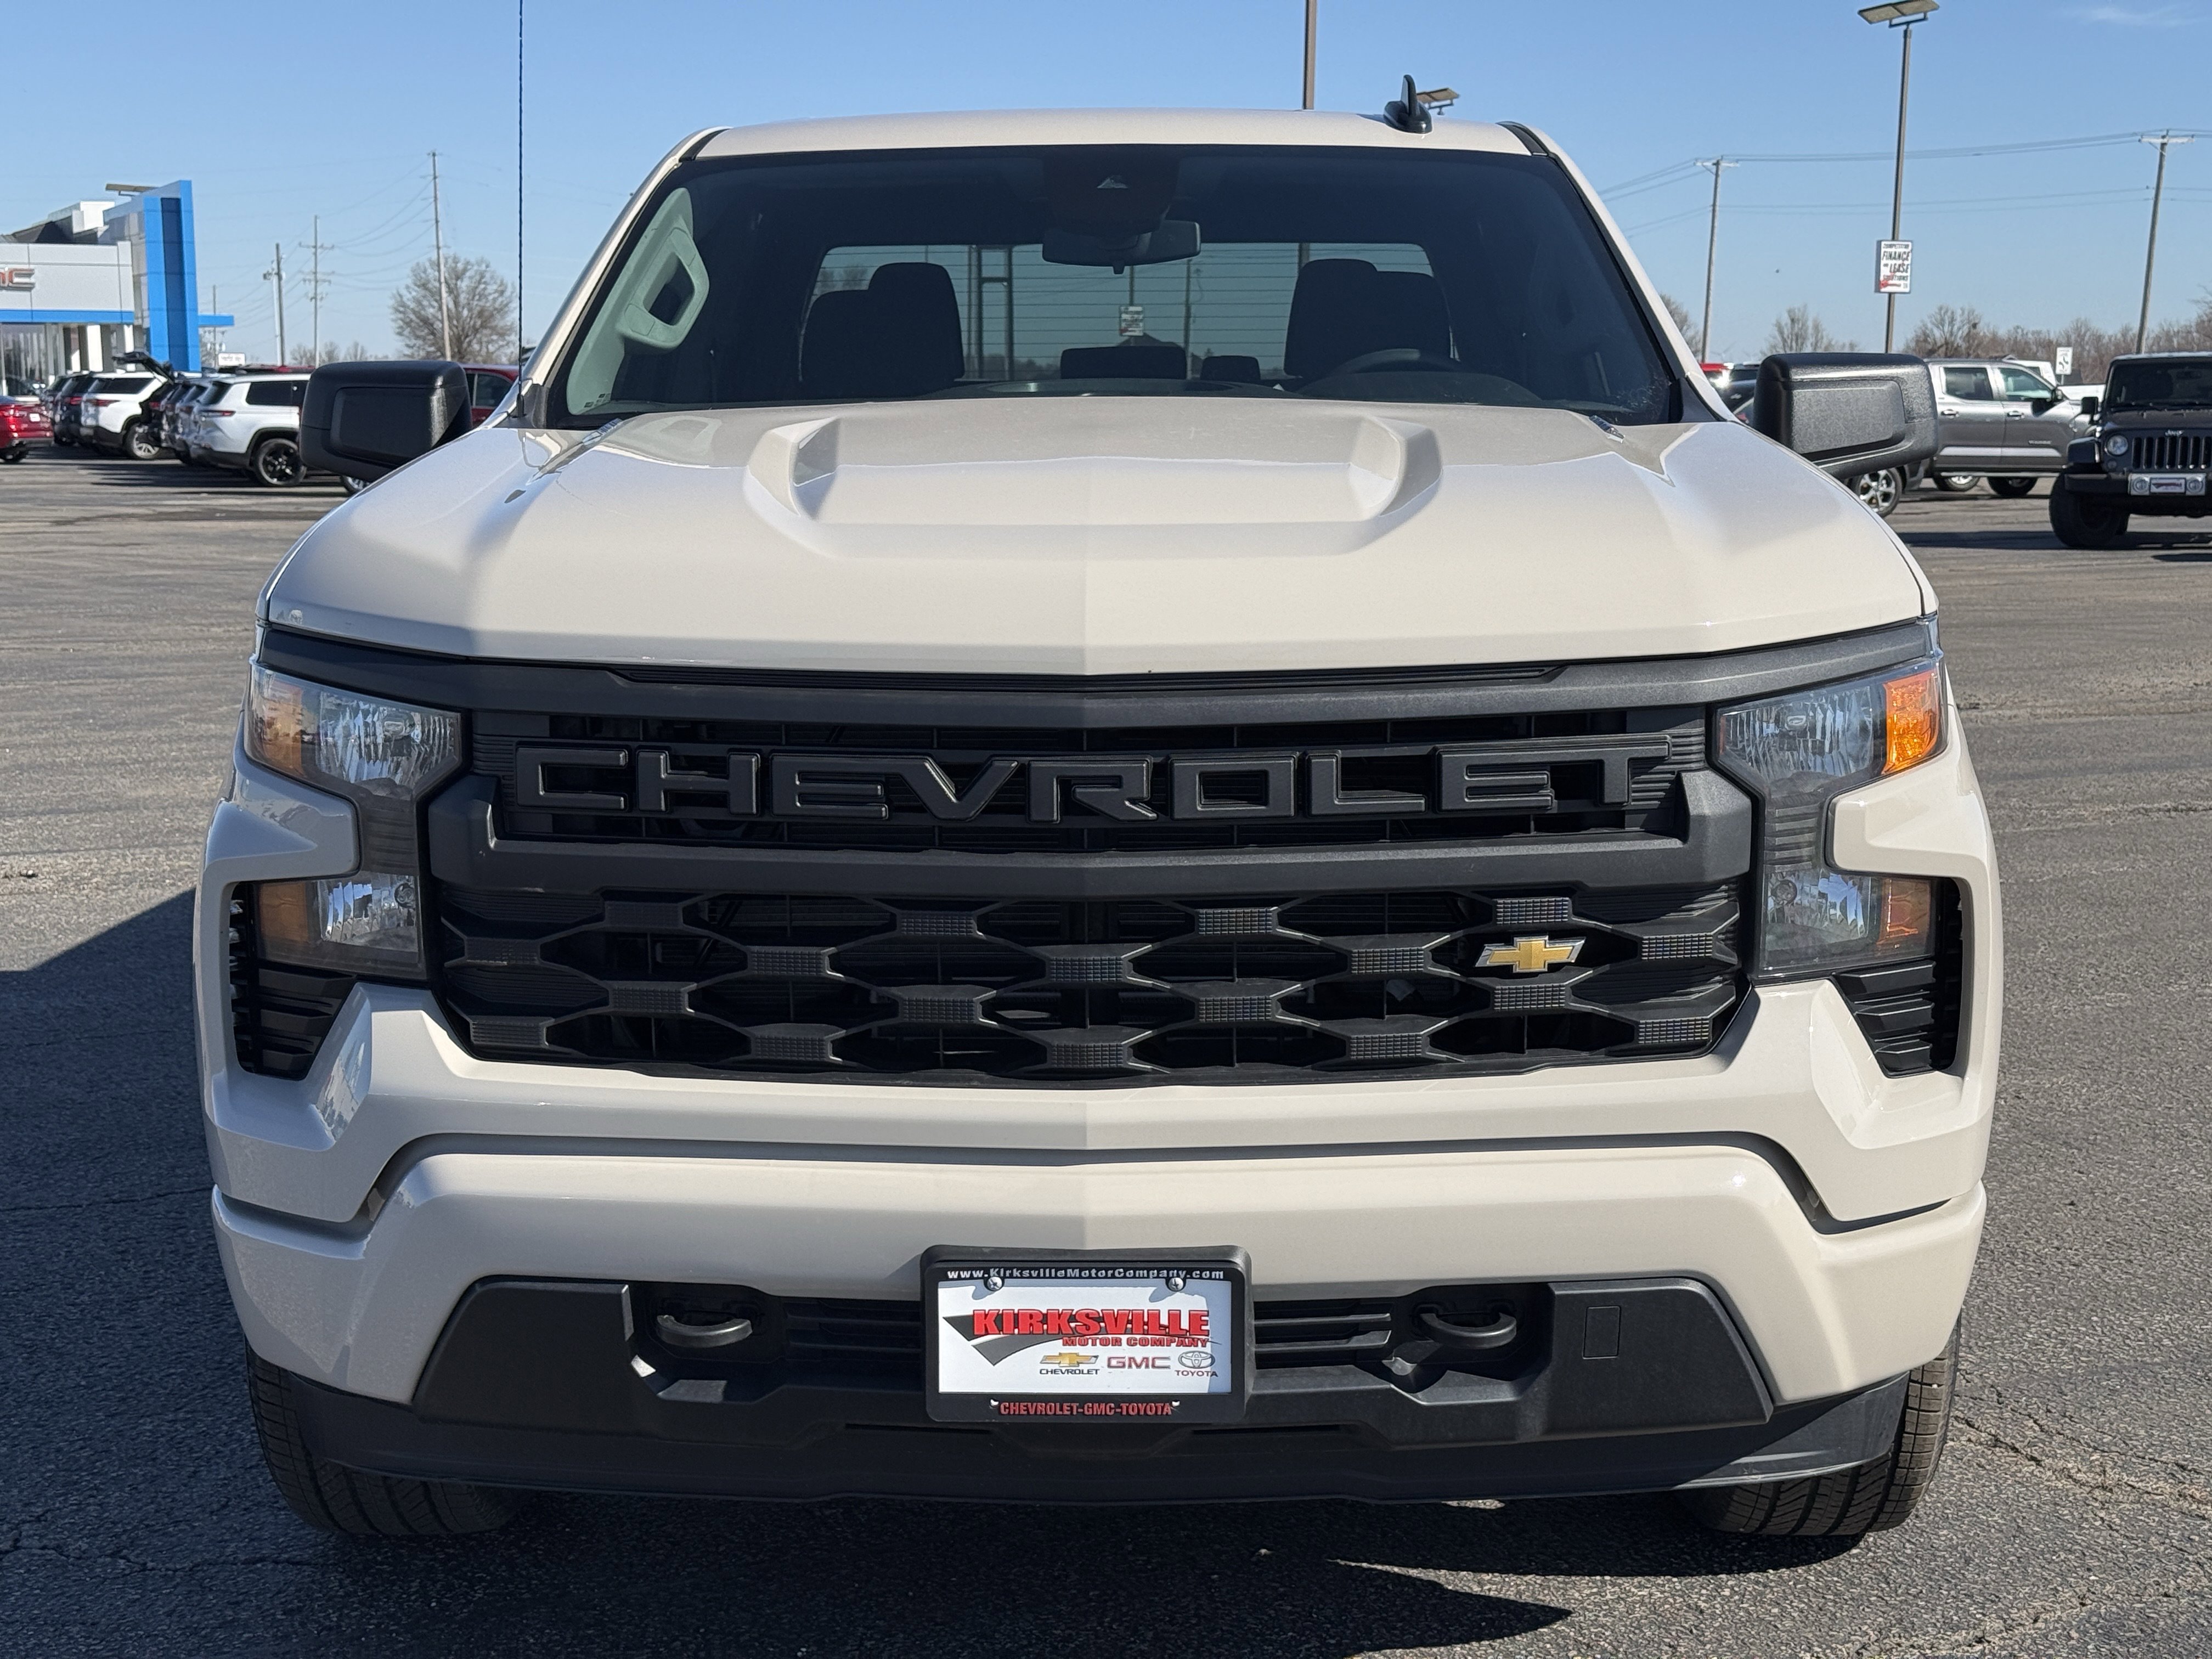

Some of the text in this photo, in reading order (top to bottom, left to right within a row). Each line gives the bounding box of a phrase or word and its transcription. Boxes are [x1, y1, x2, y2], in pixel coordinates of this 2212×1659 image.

[1882, 251, 1910, 261] FINANCE
[516, 734, 1672, 822] CHEVROLET
[947, 1268, 1224, 1279] www.KirksvilleMotorCompany.com
[973, 1309, 1210, 1336] KIRKSVILLE
[1062, 1337, 1209, 1347] MOTOR COMPANY
[1107, 1356, 1171, 1369] GMC
[1000, 1402, 1172, 1415] CHEVROLET-GMC-TOYOTA
